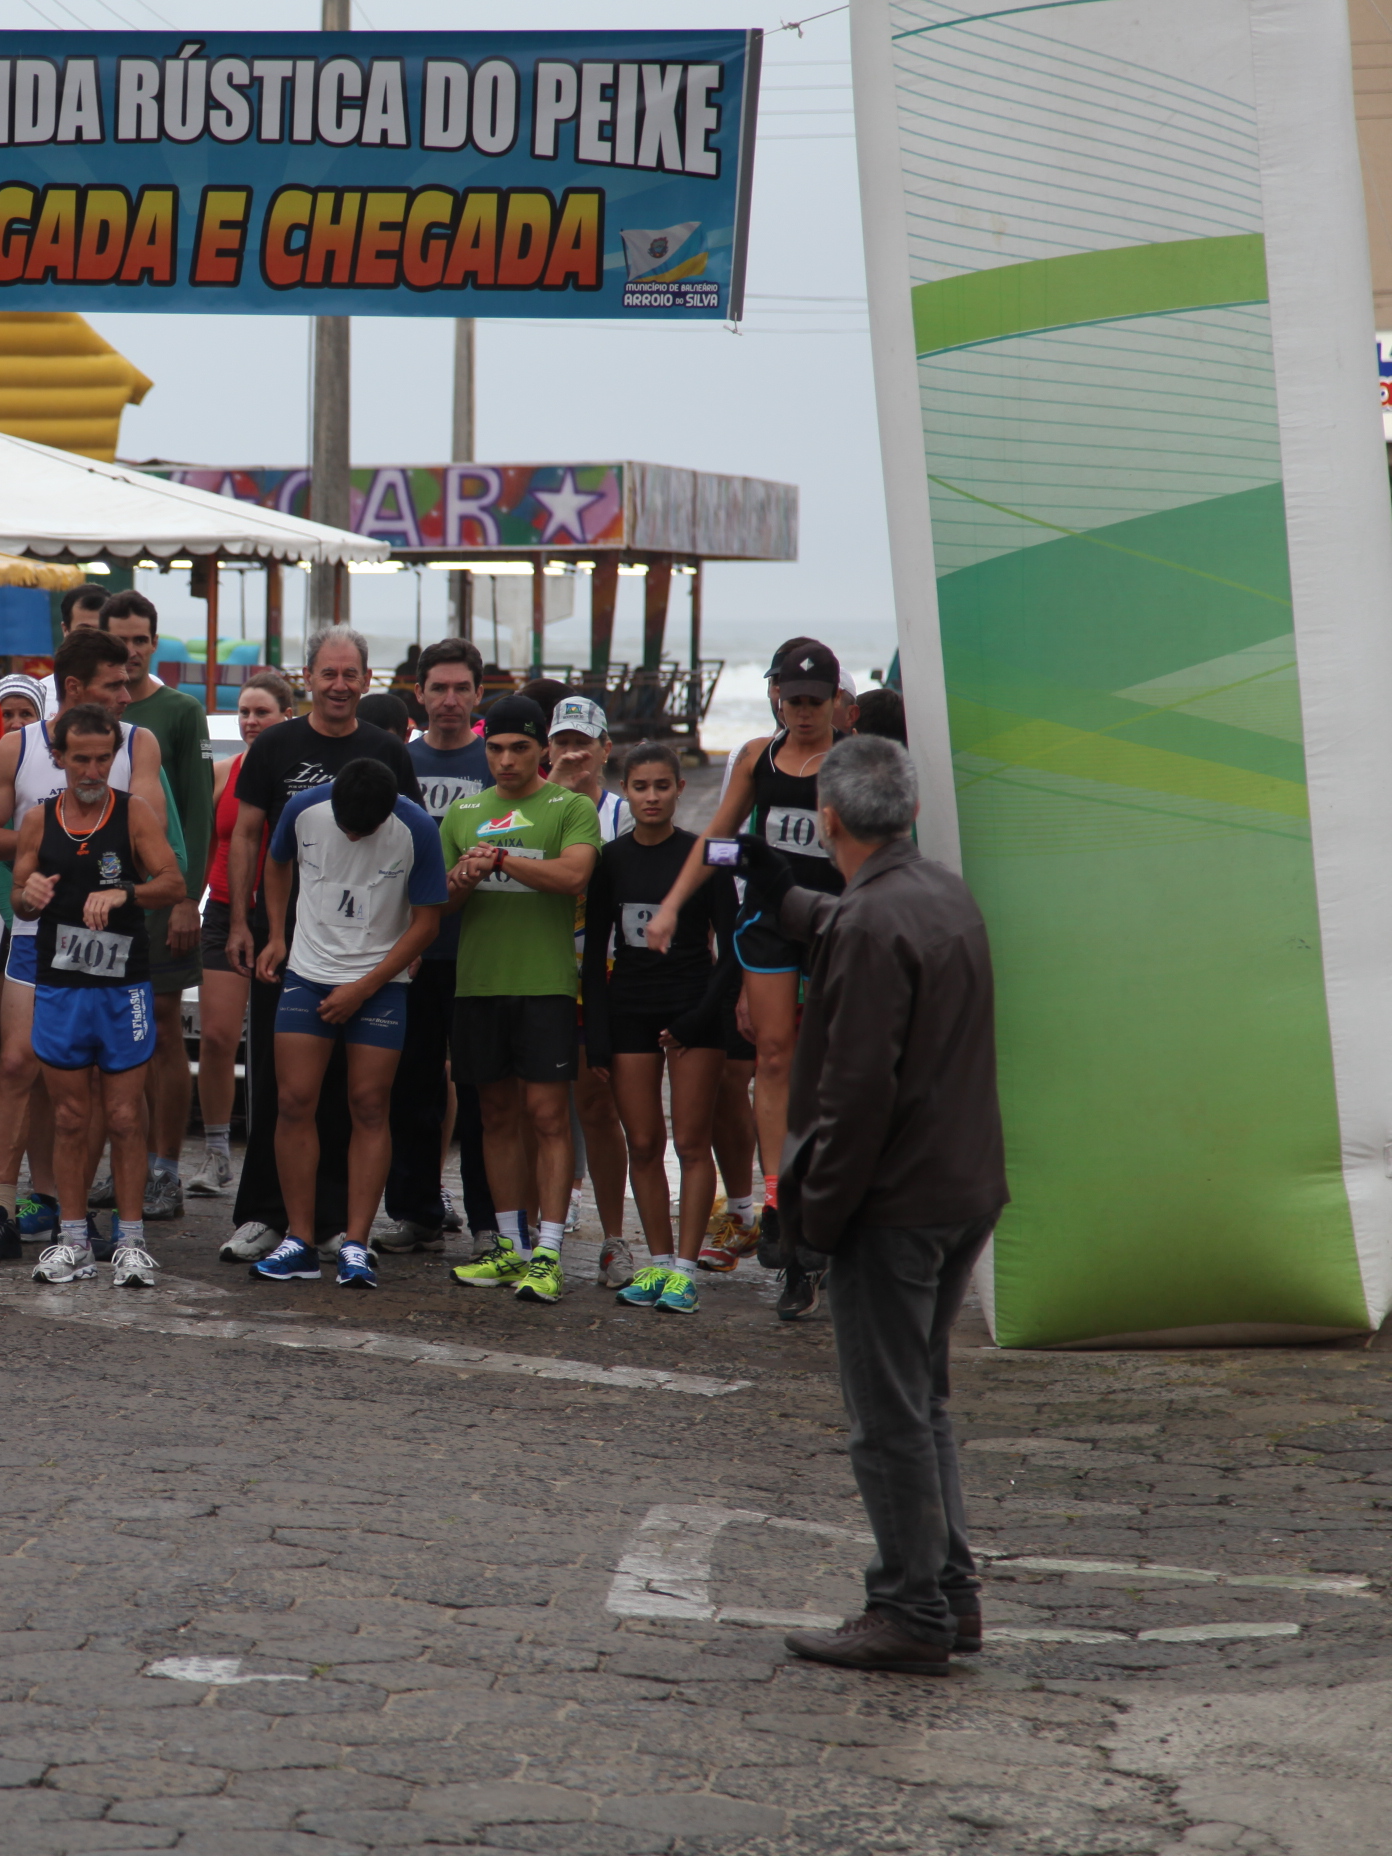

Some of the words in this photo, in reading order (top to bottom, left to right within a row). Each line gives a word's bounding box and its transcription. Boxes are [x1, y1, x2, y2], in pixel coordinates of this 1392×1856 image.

[114, 43, 411, 149] RÚSTICA
[419, 56, 520, 156] DO
[531, 58, 723, 177] PEIXE
[189, 184, 253, 288] E
[259, 183, 606, 292] CHEGADA
[625, 282, 667, 292] MUNICÍPIO
[669, 284, 679, 292] DE
[681, 283, 718, 292] BALNEÁRIO
[624, 294, 673, 306] ARROIO
[686, 294, 718, 307] SILVA
[459, 802, 481, 810] CAIXA
[485, 838, 524, 850] CAIXA
[337, 890, 355, 917] 4
[66, 934, 119, 970] 401
